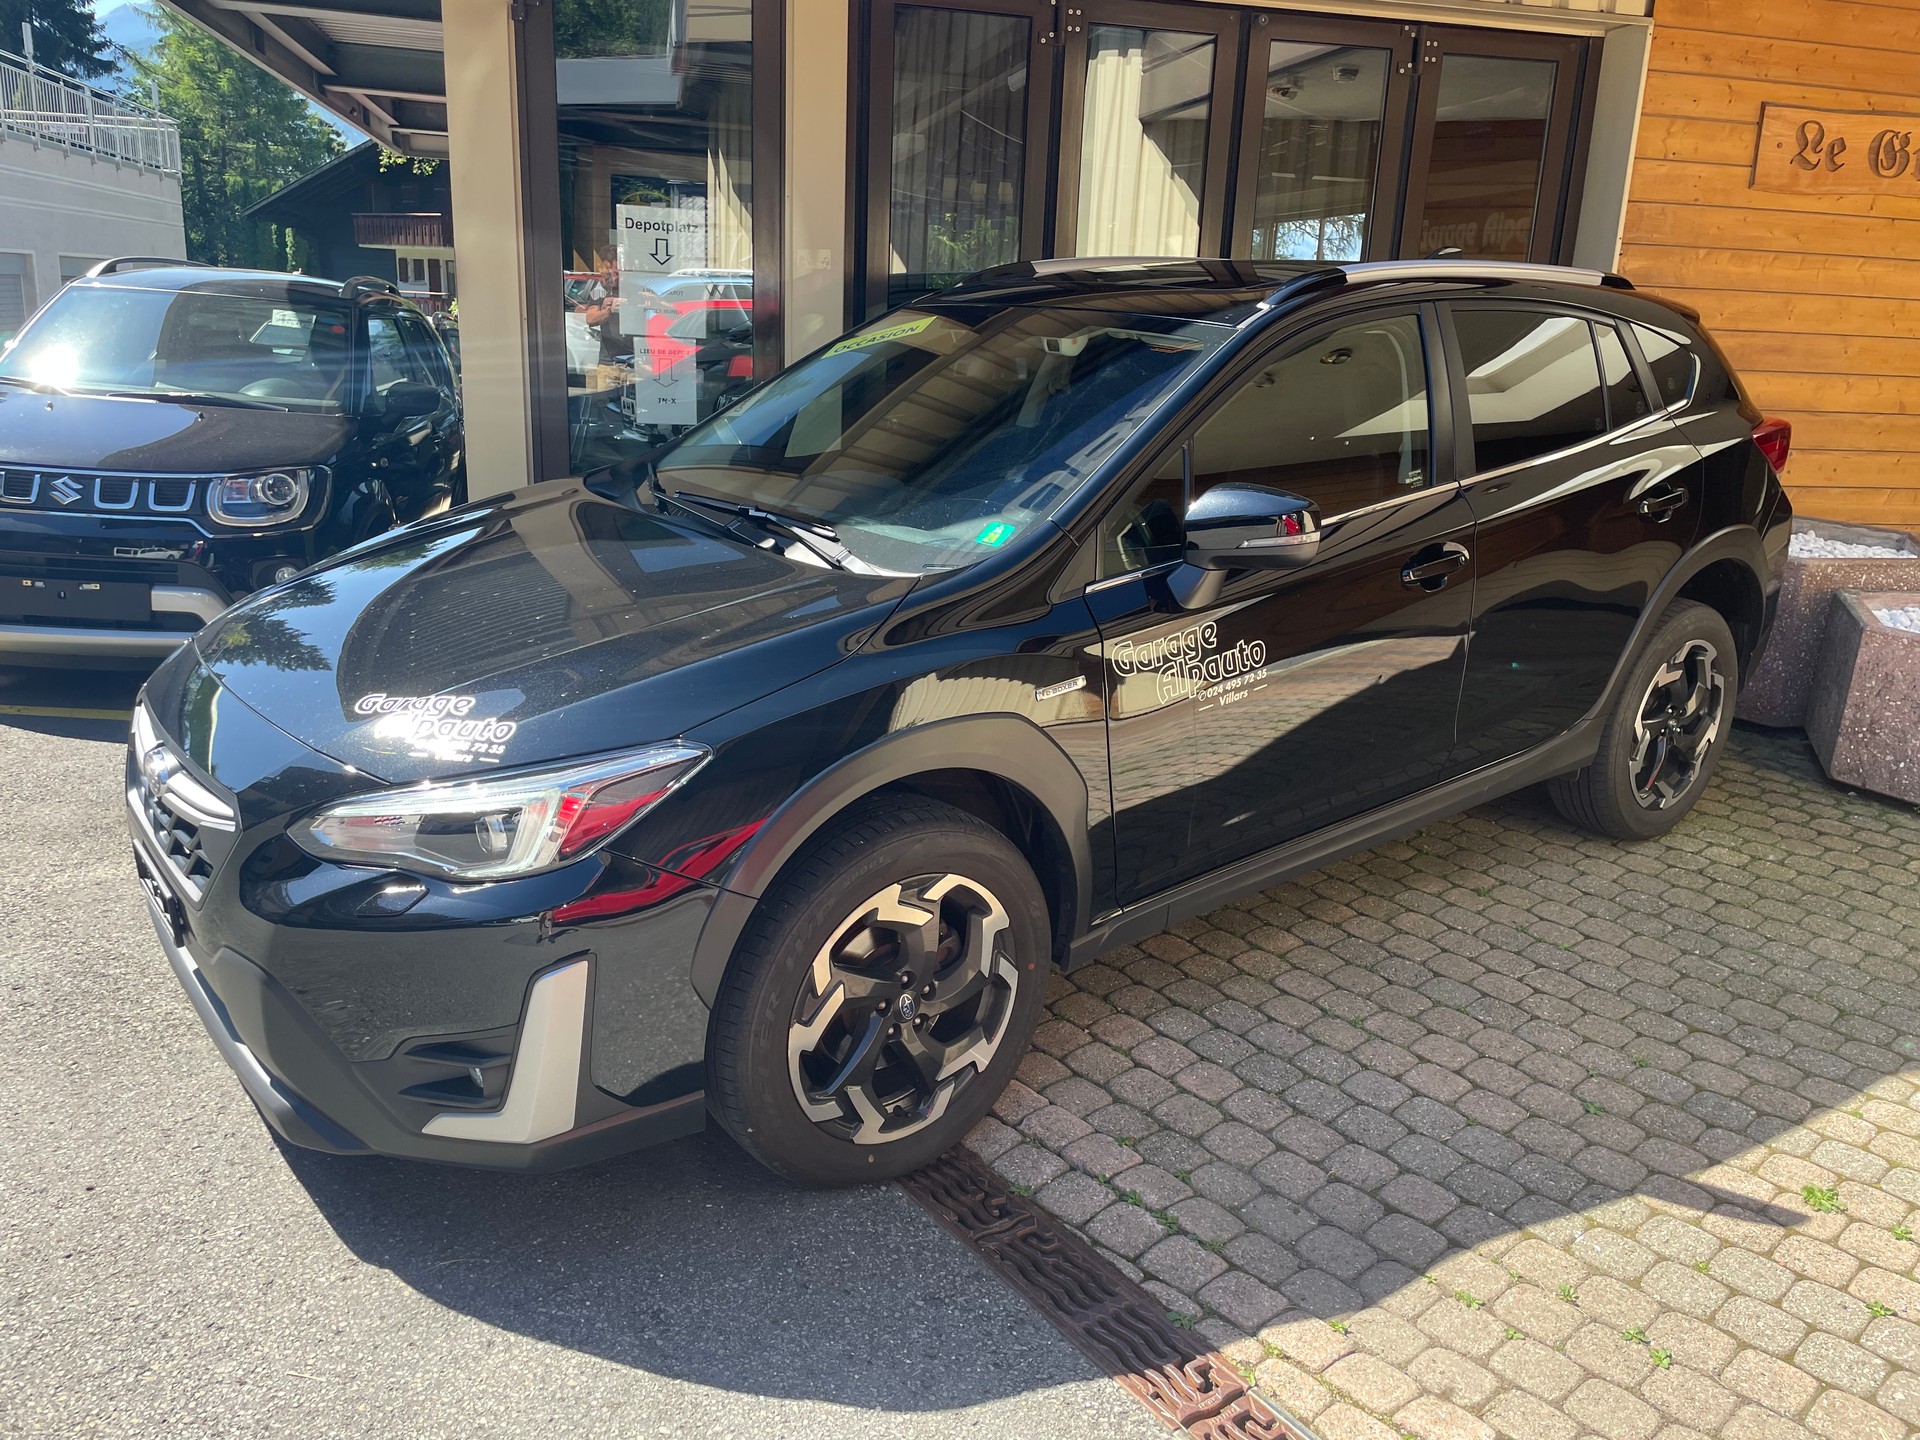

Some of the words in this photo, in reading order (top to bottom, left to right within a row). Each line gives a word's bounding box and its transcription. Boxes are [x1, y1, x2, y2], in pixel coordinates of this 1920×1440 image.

[1789, 119, 1847, 173] Le
[624, 216, 700, 235] Depotplatz
[833, 324, 921, 354] OCCASION
[639, 348, 656, 356] LIEU
[657, 348, 667, 356] DE
[1111, 621, 1218, 677] Garage
[1156, 638, 1267, 705] Alpauto
[1225, 677, 1242, 691] 495
[1243, 672, 1255, 686] 72
[1256, 667, 1267, 681] 35
[354, 693, 476, 718] Garage
[1218, 689, 1249, 707] Villars
